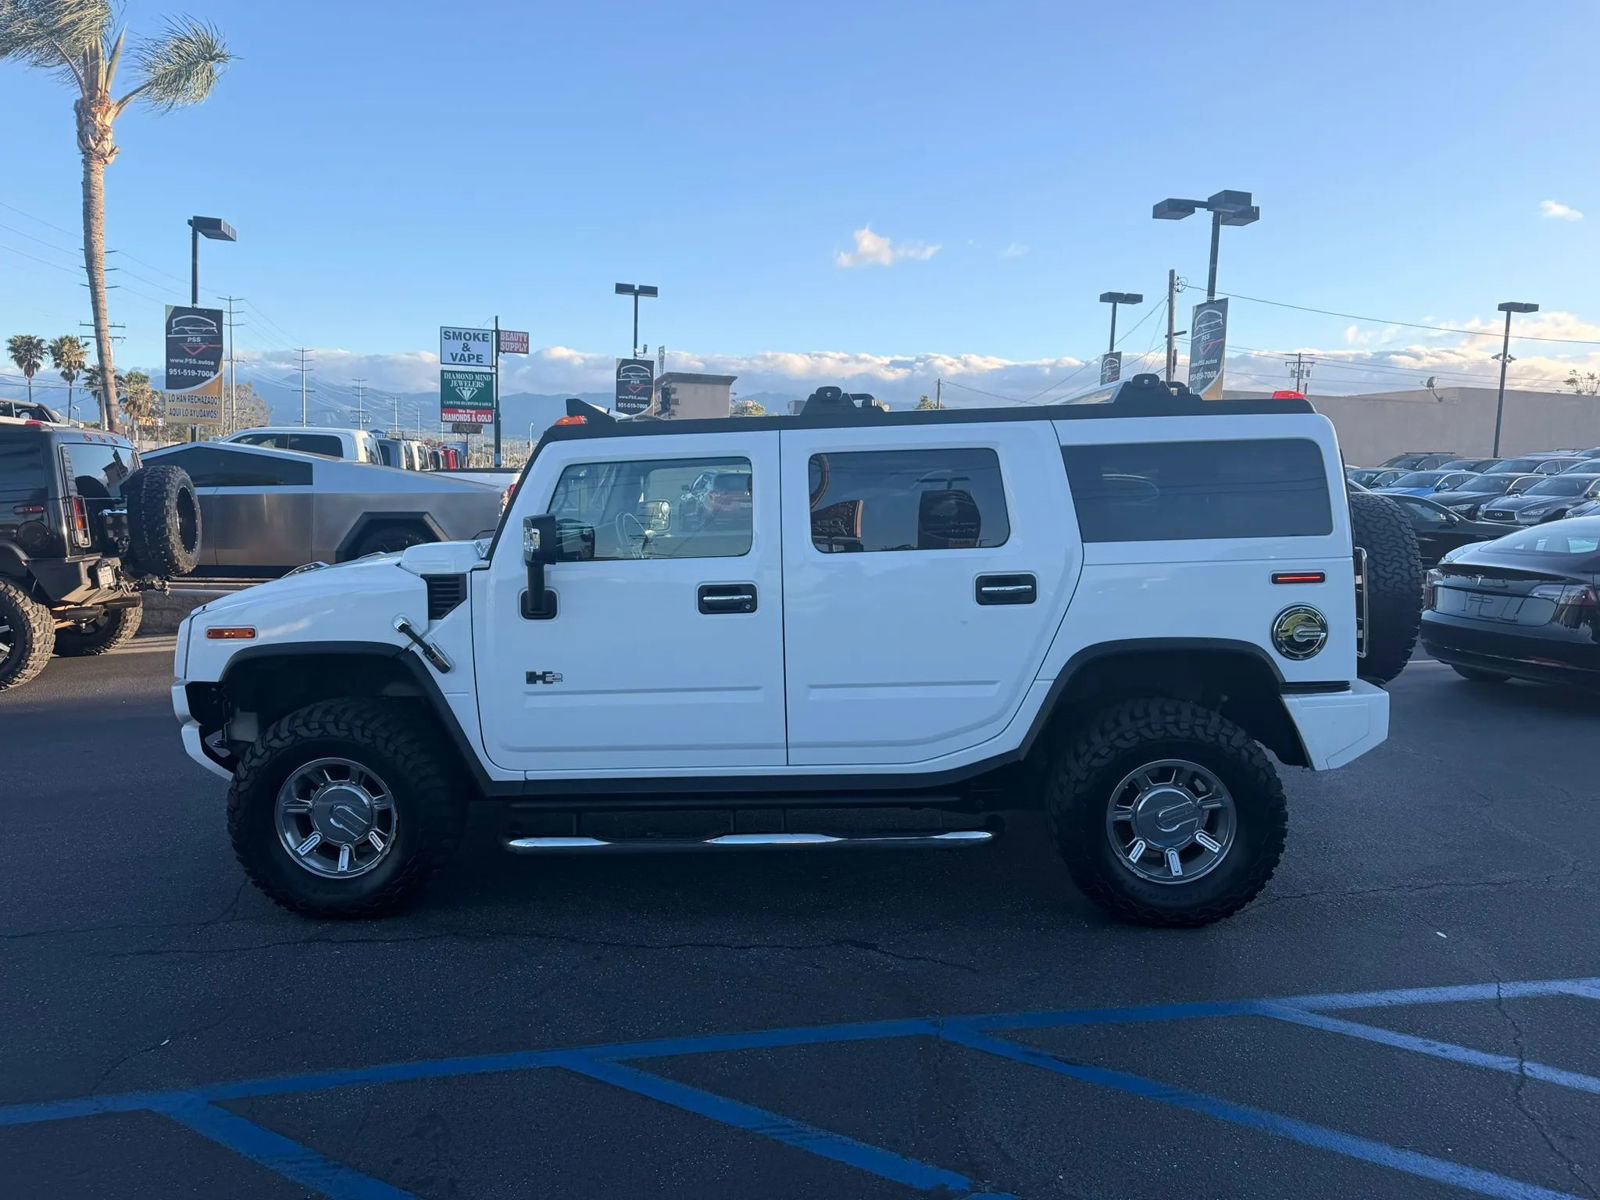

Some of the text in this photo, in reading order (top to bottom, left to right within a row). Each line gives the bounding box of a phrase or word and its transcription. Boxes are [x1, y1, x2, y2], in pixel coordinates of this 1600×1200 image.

[443, 330, 489, 342] SMOKE
[500, 332, 528, 342] BEAUTY
[462, 342, 471, 352] &
[500, 342, 528, 352] SUPPLY
[450, 352, 484, 363] VAPE
[444, 372, 474, 380] DIAMOND
[450, 380, 485, 388] JEWELERS
[168, 393, 176, 403] LO
[442, 413, 492, 423] DIAMONDS & GOLD
[525, 671, 563, 685] H2
